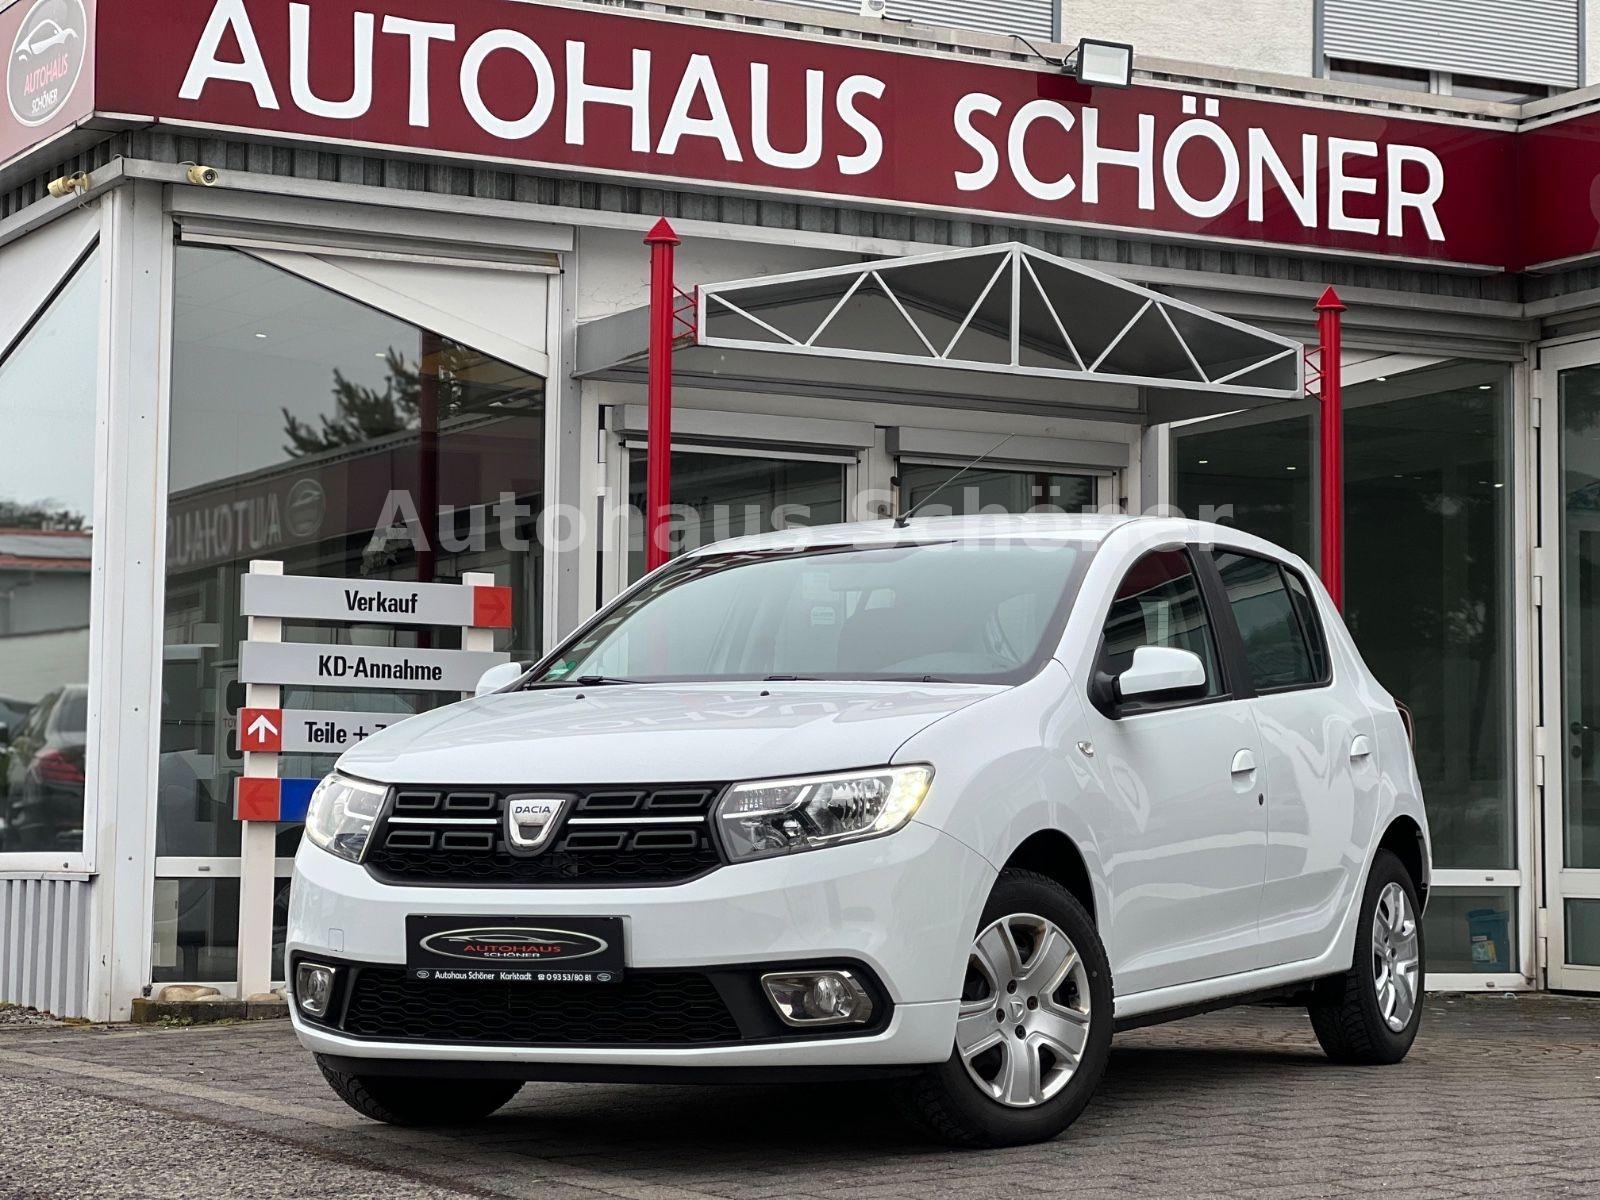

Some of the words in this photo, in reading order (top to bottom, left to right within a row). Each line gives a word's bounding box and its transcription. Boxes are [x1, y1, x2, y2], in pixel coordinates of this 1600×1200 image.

[24, 53, 68, 96] AUTOHAUS
[31, 88, 58, 114] SCHÖNER
[178, 0, 885, 175] AUTOHAUS
[953, 93, 1446, 242] SCHÖNER
[344, 589, 418, 614] Verkauf
[318, 655, 442, 680] KD-Annahme
[304, 721, 347, 743] Teile
[463, 945, 561, 953] AUTOHAUS
[435, 971, 467, 979] Autohaus
[468, 971, 495, 980] Schöner
[500, 972, 532, 981] Karlstadt
